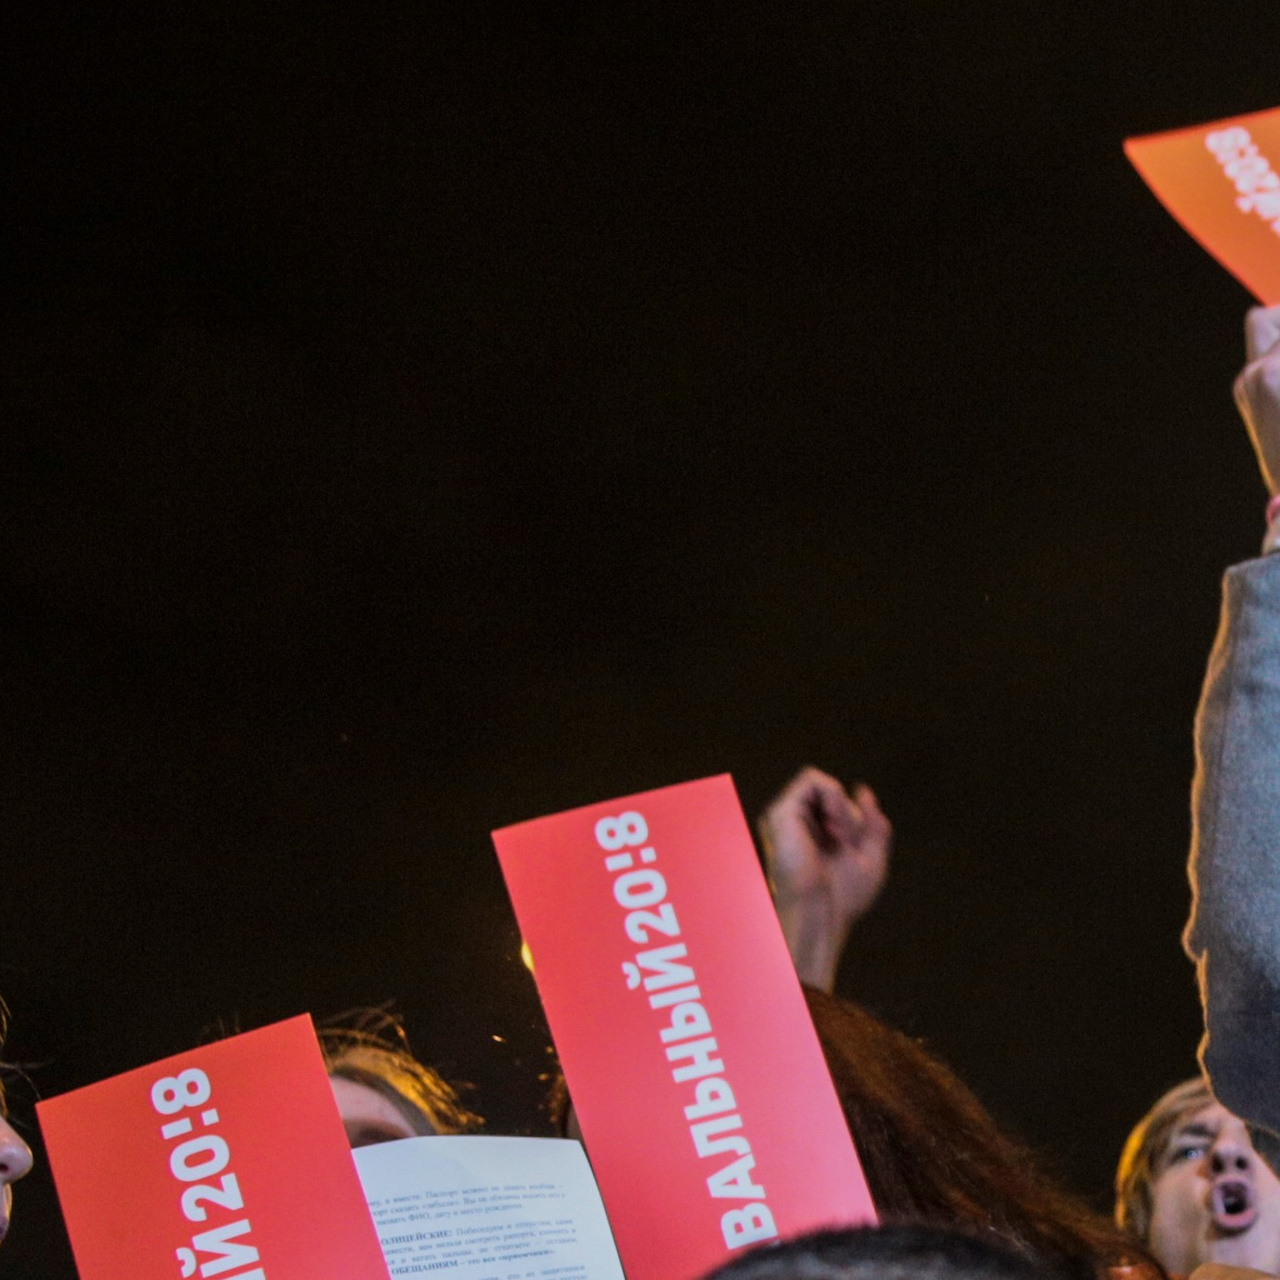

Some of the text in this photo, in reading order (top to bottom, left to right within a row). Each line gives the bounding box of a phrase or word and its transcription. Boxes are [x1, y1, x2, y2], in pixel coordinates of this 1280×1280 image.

[595, 810, 780, 1251] ВАЛЬНЫЙ20!8
[380, 1229, 452, 1244] ОЛИЦЕЙСКИЕ!
[391, 1259, 458, 1274] ОБЕЩАНИЯМ
